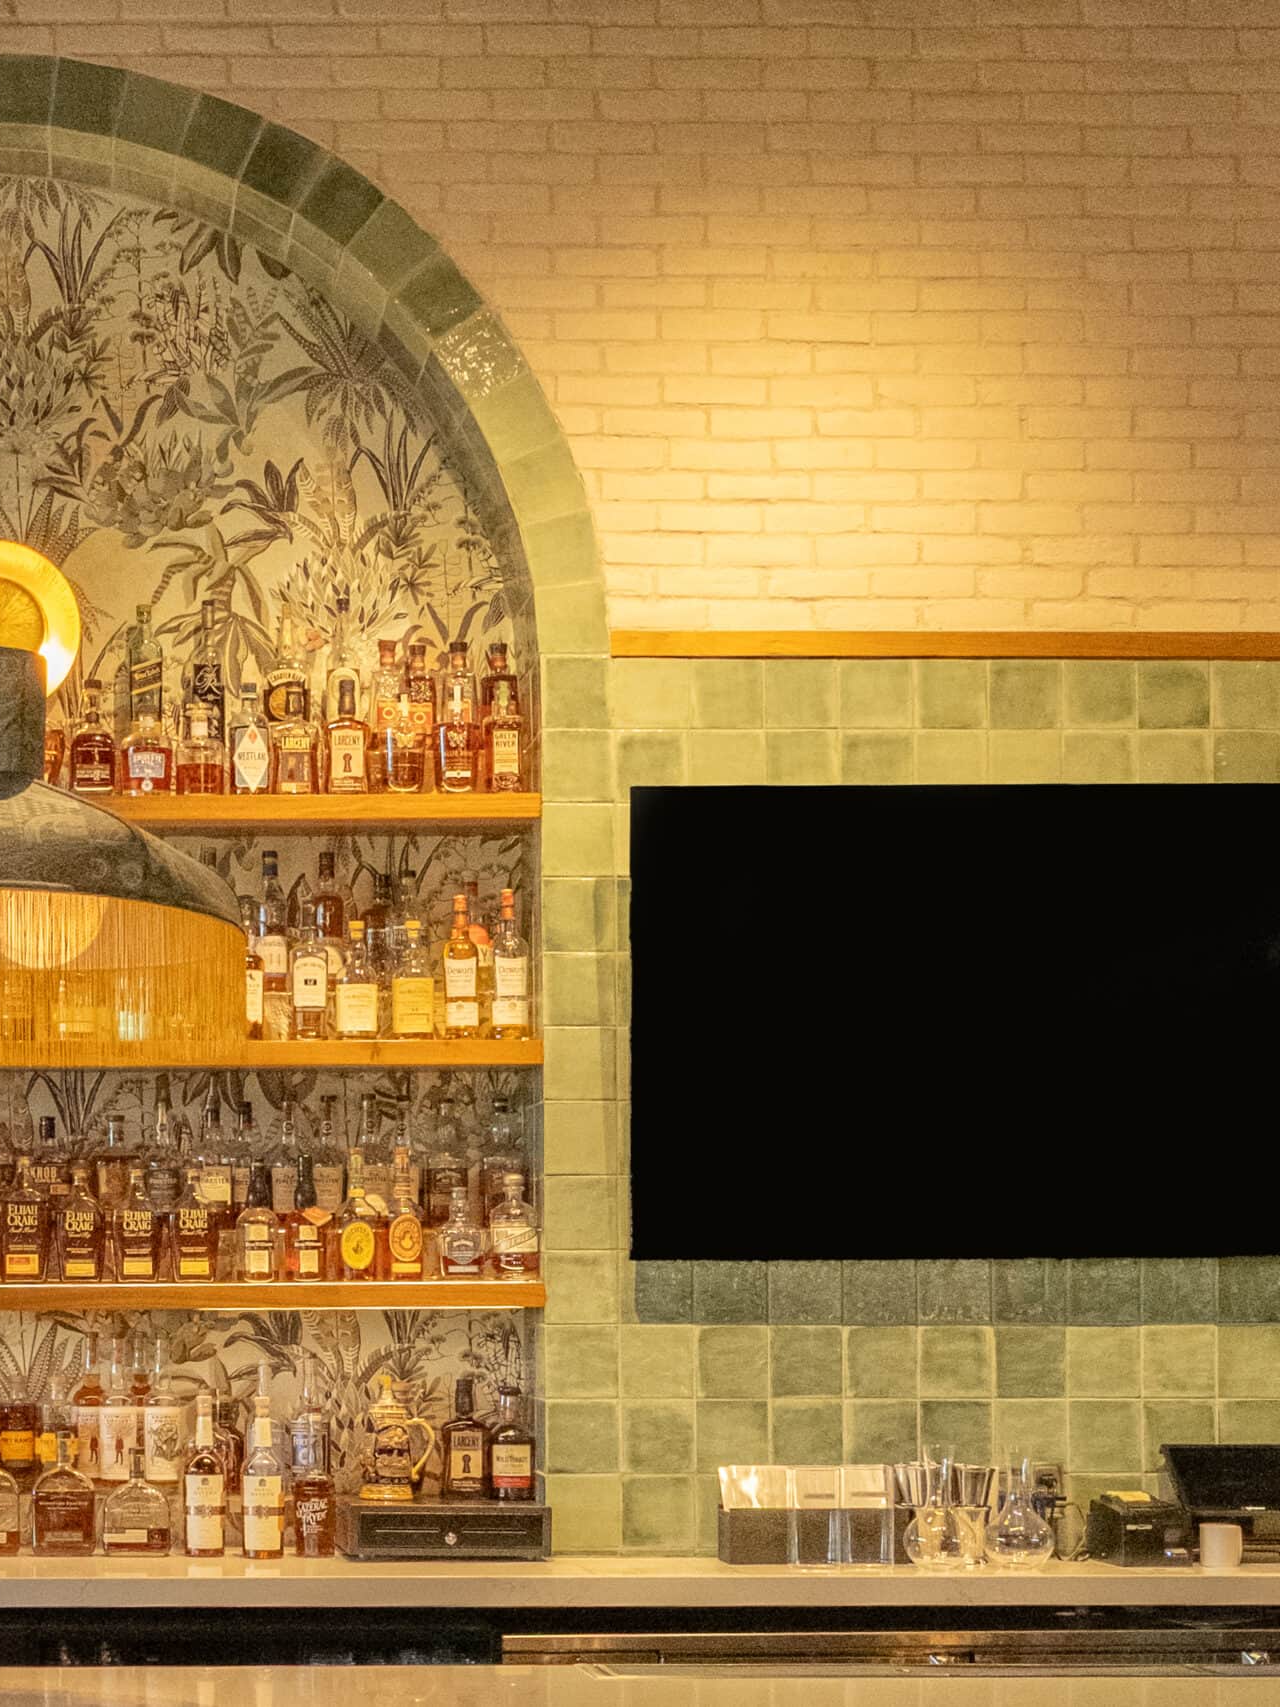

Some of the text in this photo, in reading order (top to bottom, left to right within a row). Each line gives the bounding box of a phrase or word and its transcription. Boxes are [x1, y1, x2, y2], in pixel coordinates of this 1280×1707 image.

[8, 1204, 38, 1215] ELIJAH
[179, 1208, 208, 1219] ELIJAH
[7, 1215, 38, 1227] CRAIG
[65, 1210, 94, 1221] ELIJAH
[123, 1210, 152, 1221] ELIJAH
[65, 1221, 94, 1232] CRAIG
[123, 1221, 151, 1231] CRAIG
[179, 1219, 208, 1230] CRAIG
[296, 1498, 328, 1513] SAZERAC
